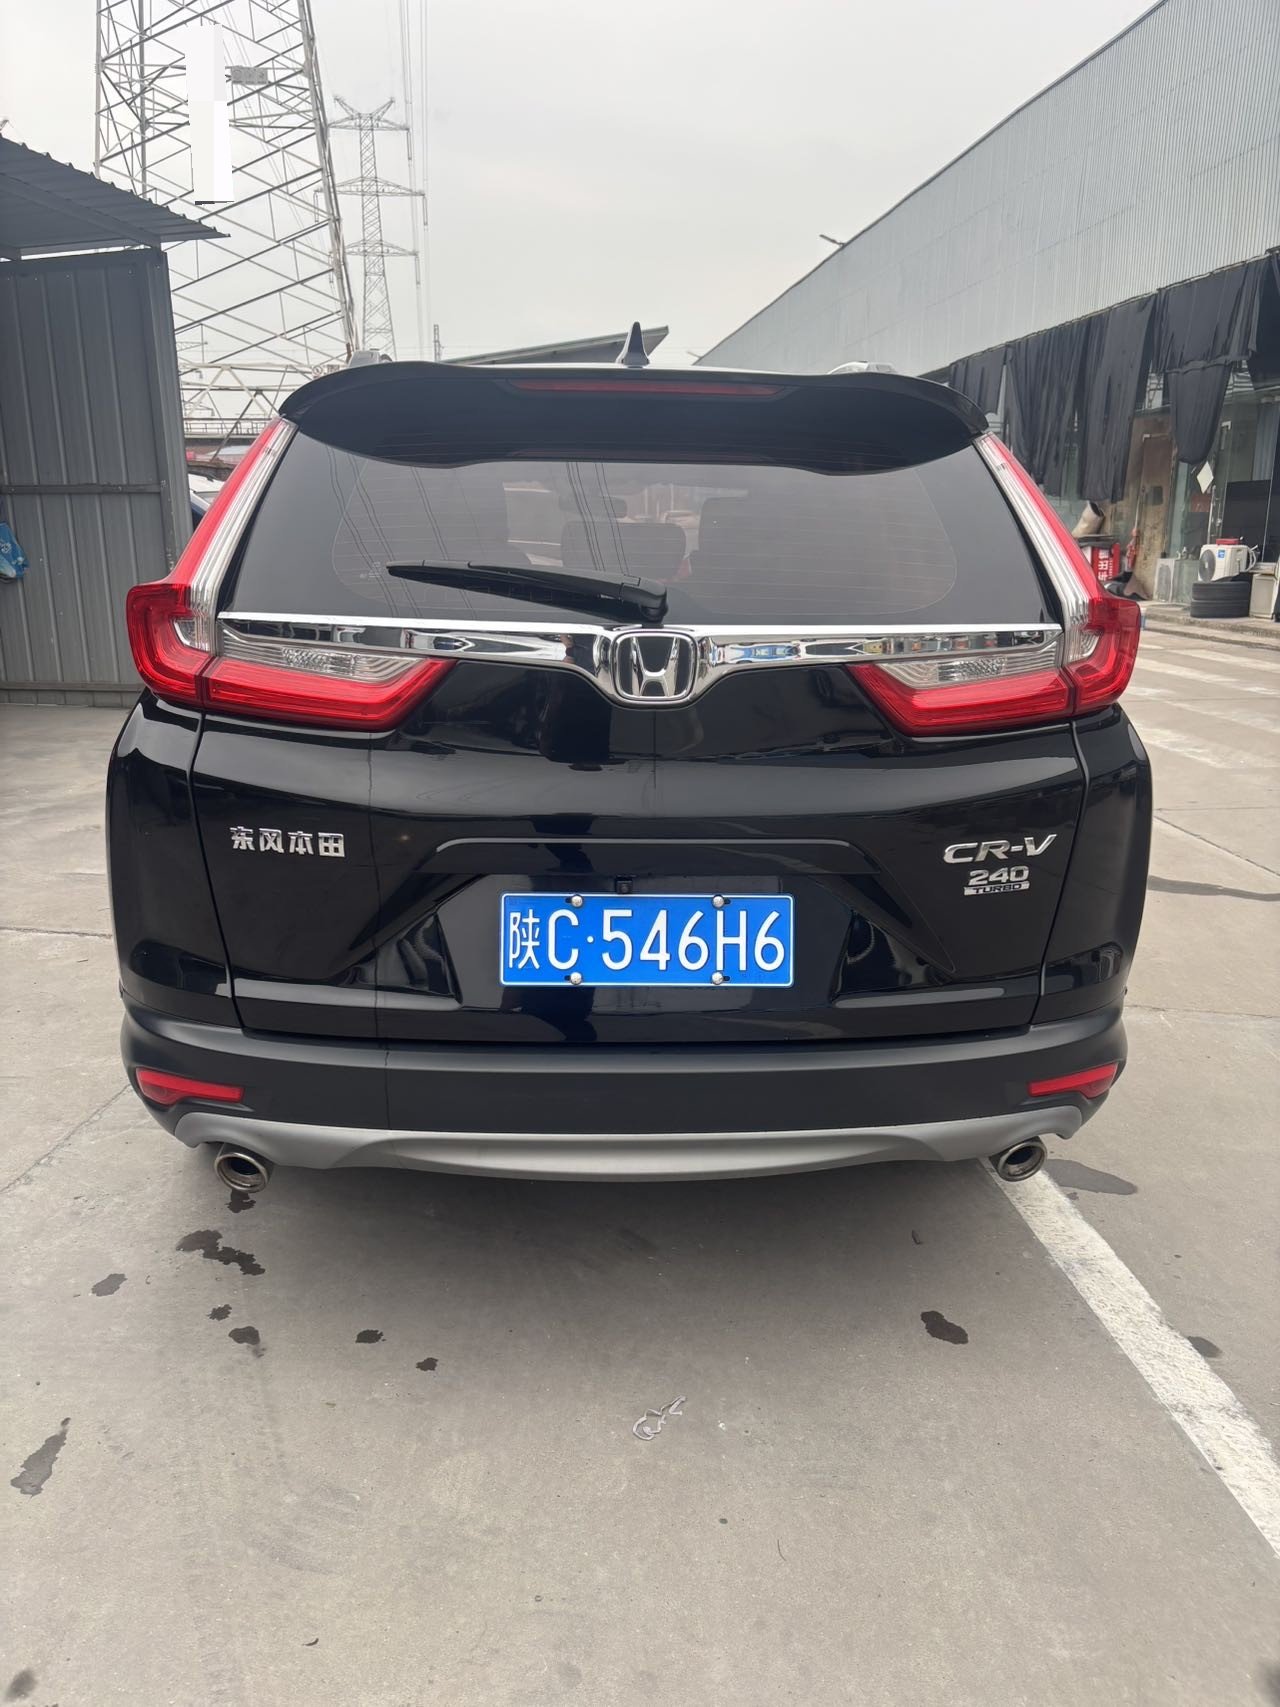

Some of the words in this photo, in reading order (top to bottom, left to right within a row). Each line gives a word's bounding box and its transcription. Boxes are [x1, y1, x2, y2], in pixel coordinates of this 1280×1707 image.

[229, 826, 345, 858] 东风本田
[943, 833, 1058, 864] CR-V
[968, 865, 1030, 886] 240
[972, 883, 1023, 894] TURBO
[508, 908, 786, 971] 陕C·546H6
